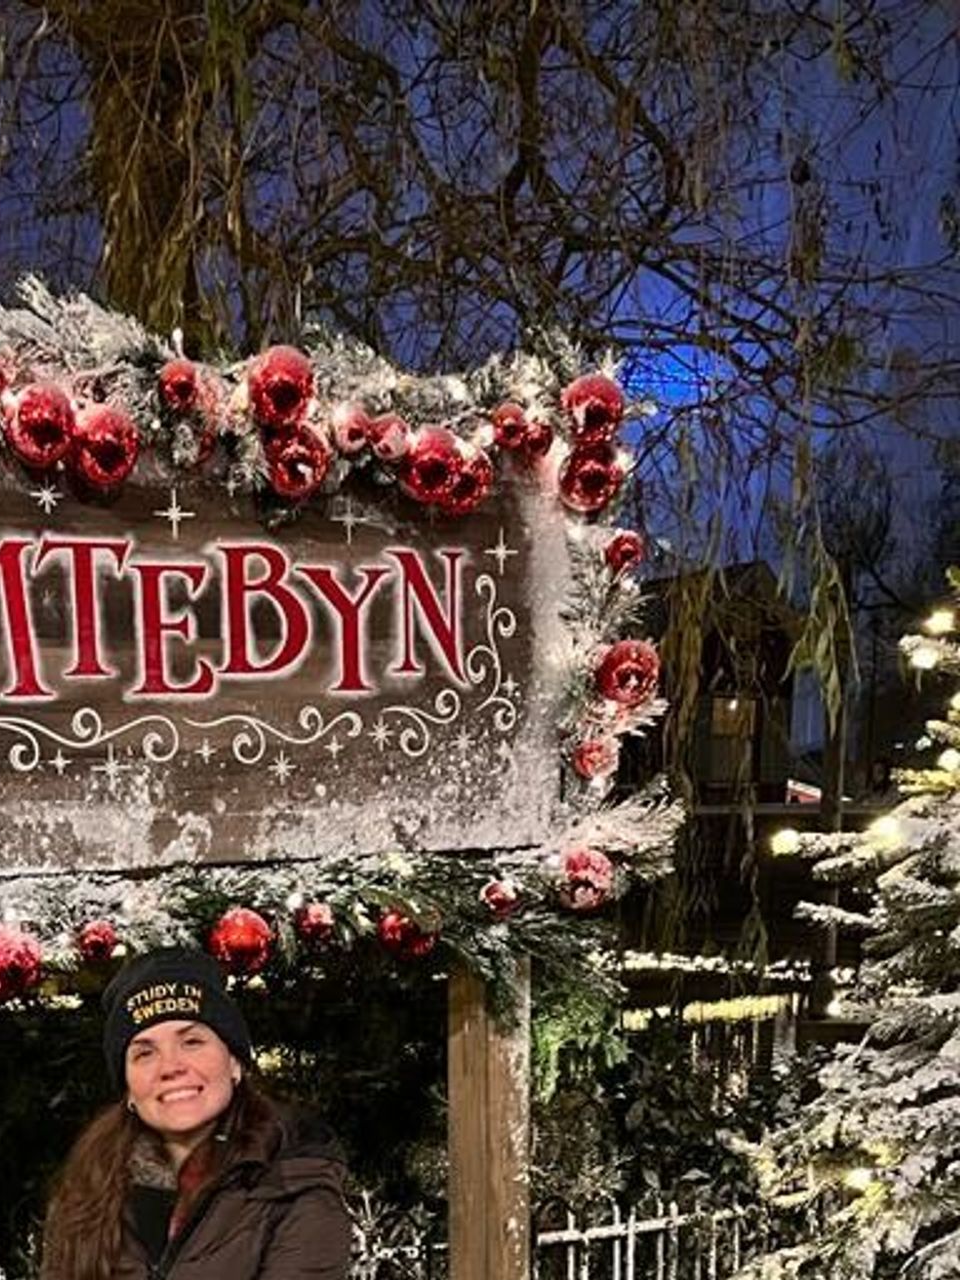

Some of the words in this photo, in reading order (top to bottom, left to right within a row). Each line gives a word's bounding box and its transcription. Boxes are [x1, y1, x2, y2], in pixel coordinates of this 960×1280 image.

[127, 982, 177, 1011] STUDY
[184, 984, 202, 999] IN
[132, 997, 200, 1024] SWEDEN
